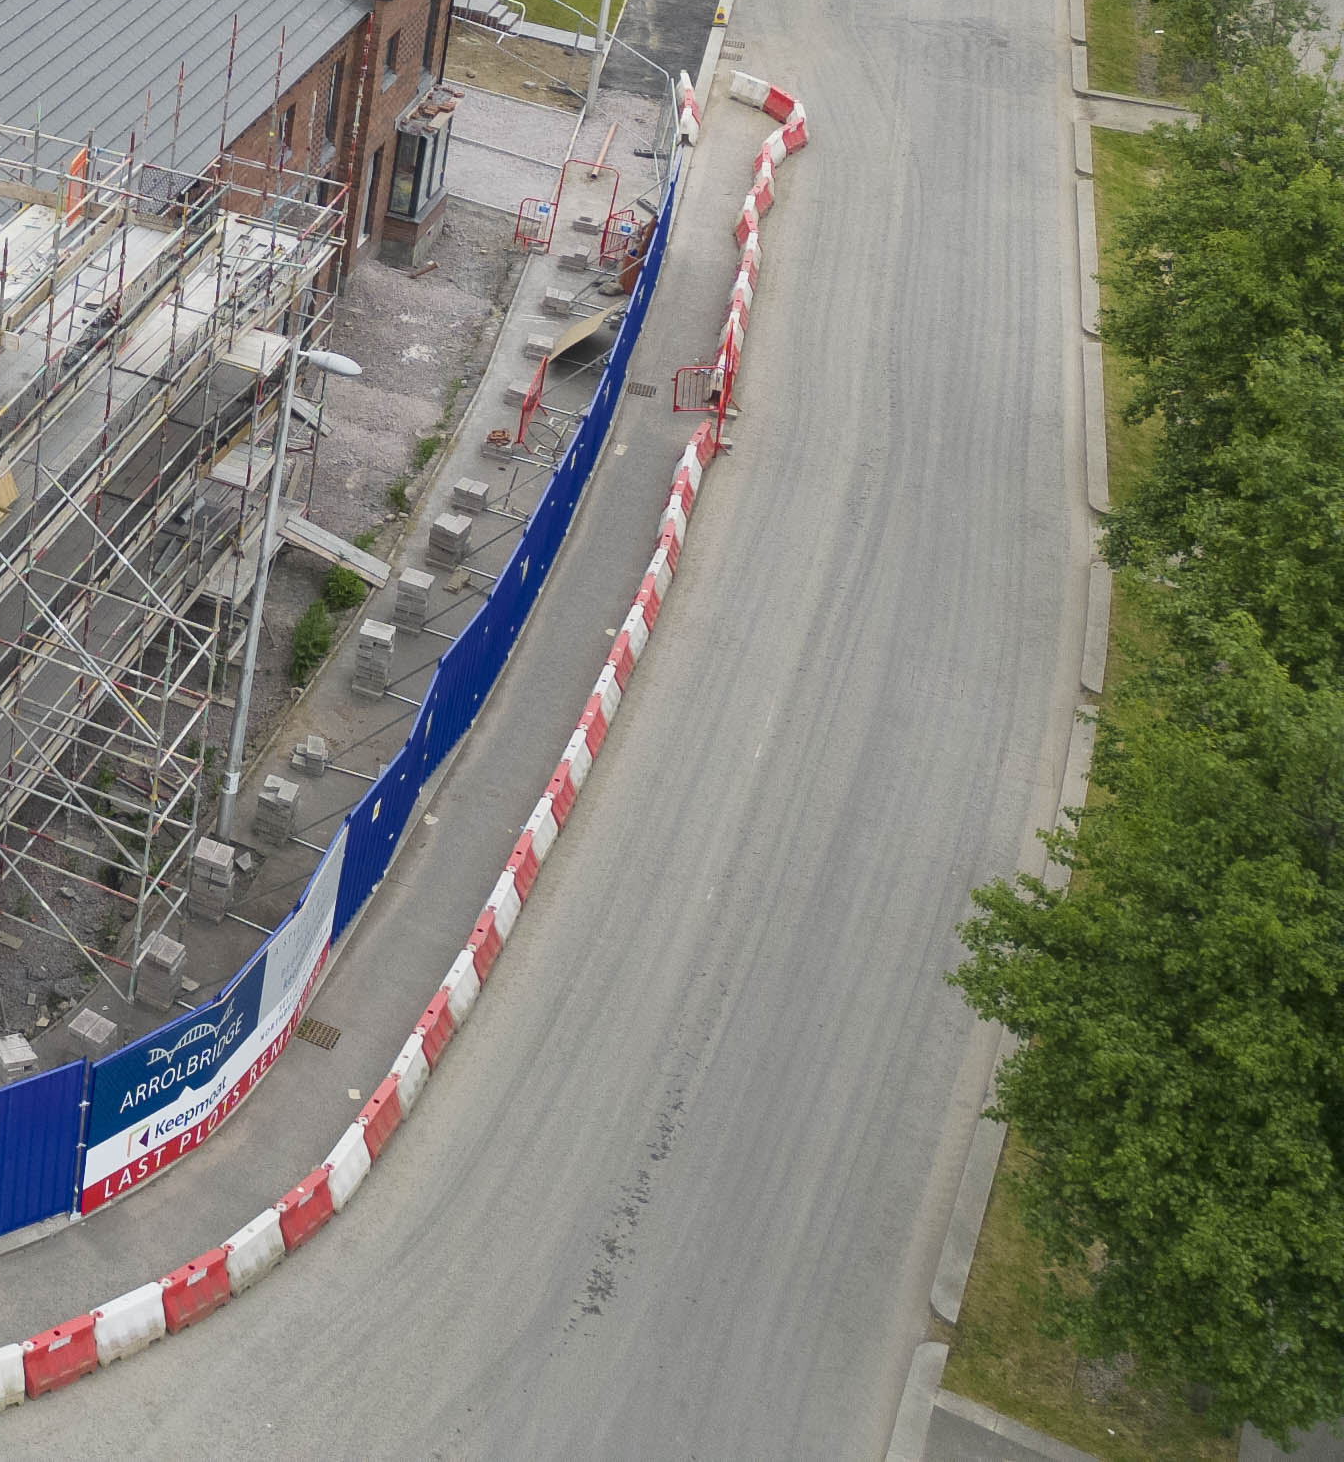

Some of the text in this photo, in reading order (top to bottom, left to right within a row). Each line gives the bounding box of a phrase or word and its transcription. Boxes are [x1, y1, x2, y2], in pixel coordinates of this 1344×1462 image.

[119, 1012, 244, 1114] ARROLBRIDGE
[154, 1075, 228, 1139] Keepmoat
[104, 1146, 163, 1198] LAST
[179, 1086, 242, 1152] PLOTS
